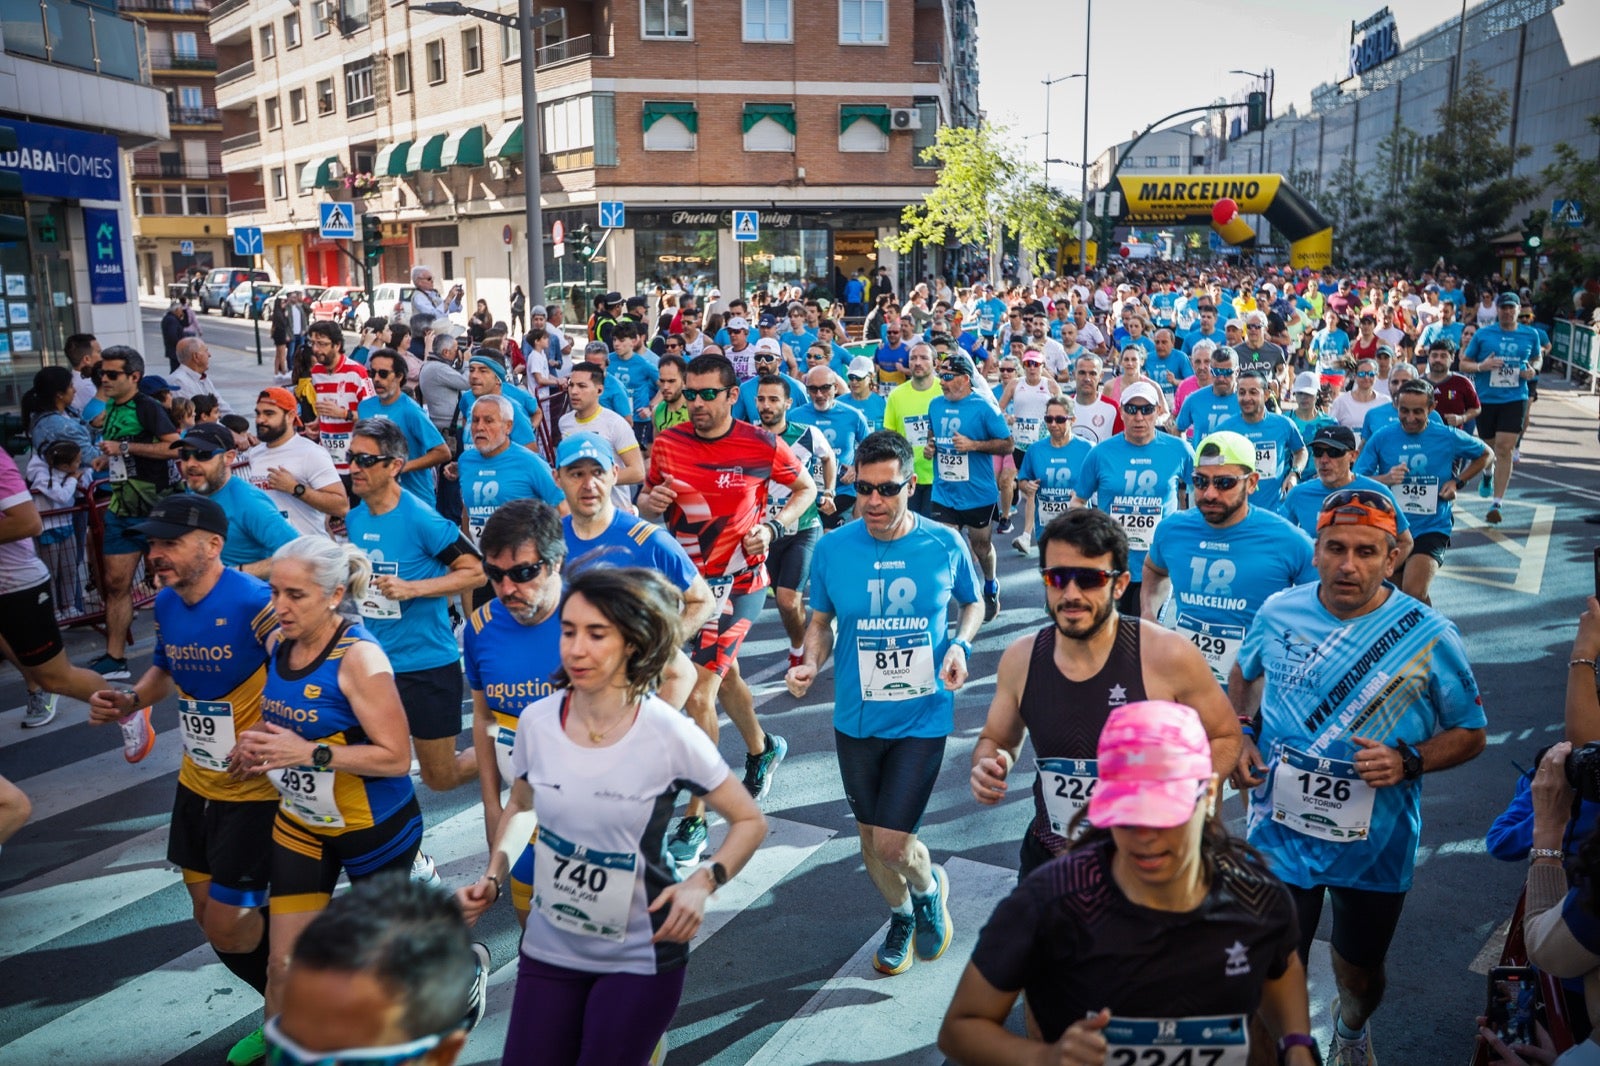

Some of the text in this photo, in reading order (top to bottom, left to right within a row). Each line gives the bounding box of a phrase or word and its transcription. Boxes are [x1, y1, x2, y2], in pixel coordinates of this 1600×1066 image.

[1138, 181, 1260, 201] MARCELINO
[671, 210, 719, 226] Puerta
[940, 453, 963, 465] 2523
[1046, 467, 1072, 488] 18
[1124, 470, 1158, 497] 18
[472, 480, 499, 505] 18
[1113, 496, 1163, 506] MARCELINO
[1402, 485, 1427, 497] 345
[1119, 514, 1155, 528] 1266
[1190, 556, 1236, 596] 18
[866, 577, 917, 617] 18
[1180, 592, 1248, 611] MARCELINO
[856, 617, 929, 631] MARCELINO
[875, 649, 914, 669] 817
[1303, 607, 1426, 735] WWW.CORTIJOPUERTA.COM
[486, 677, 560, 704] agustin
[1338, 670, 1391, 727] ALPUJARRA
[182, 714, 216, 736] 199
[280, 768, 316, 795] 493
[1298, 773, 1351, 802] 126
[1301, 795, 1343, 810] VICTORINO
[553, 855, 608, 893] 740
